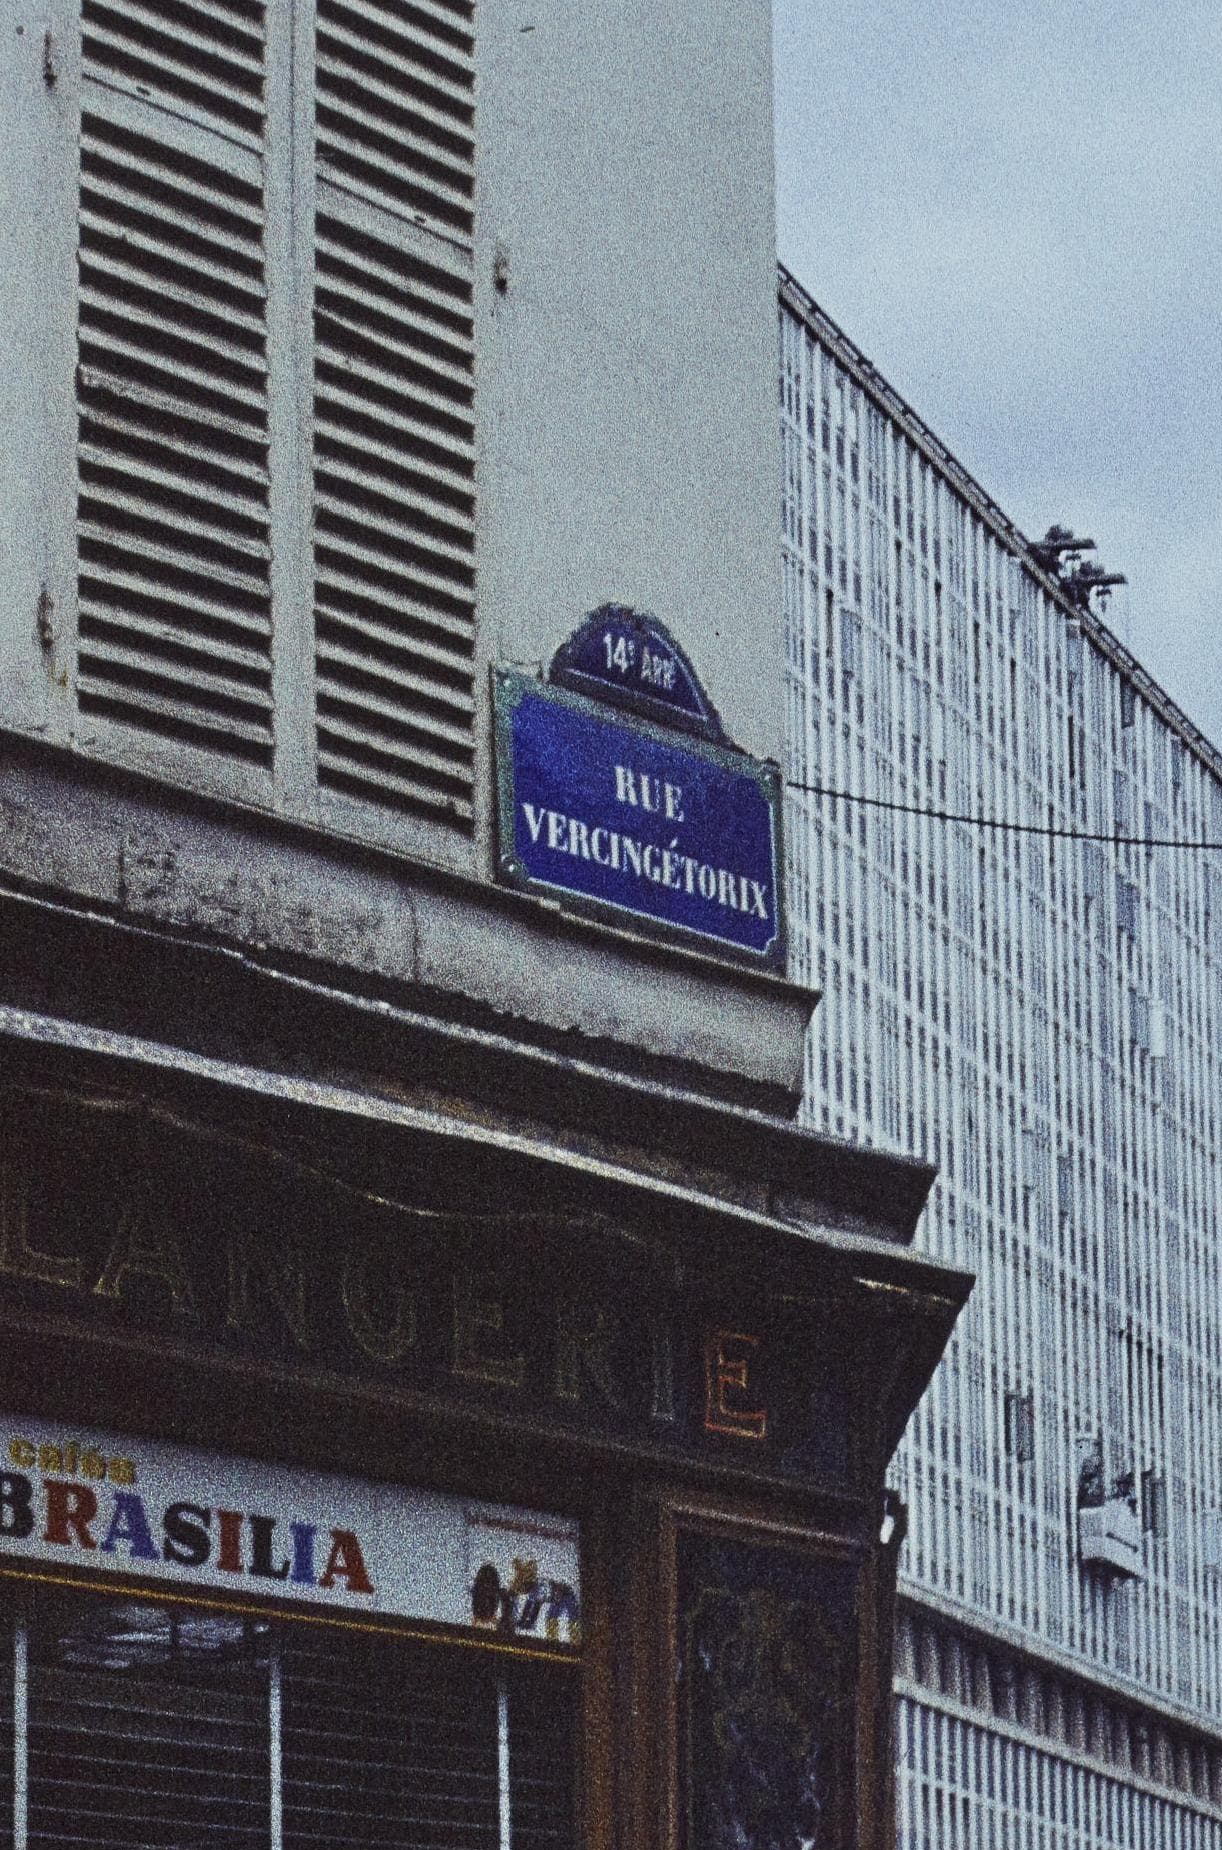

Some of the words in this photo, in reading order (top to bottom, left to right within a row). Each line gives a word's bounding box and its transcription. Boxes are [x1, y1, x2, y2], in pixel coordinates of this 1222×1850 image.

[614, 765, 685, 823] RUE
[522, 802, 769, 920] VERCINGÉTORIX
[0, 1472, 374, 1596] BRASILIA
